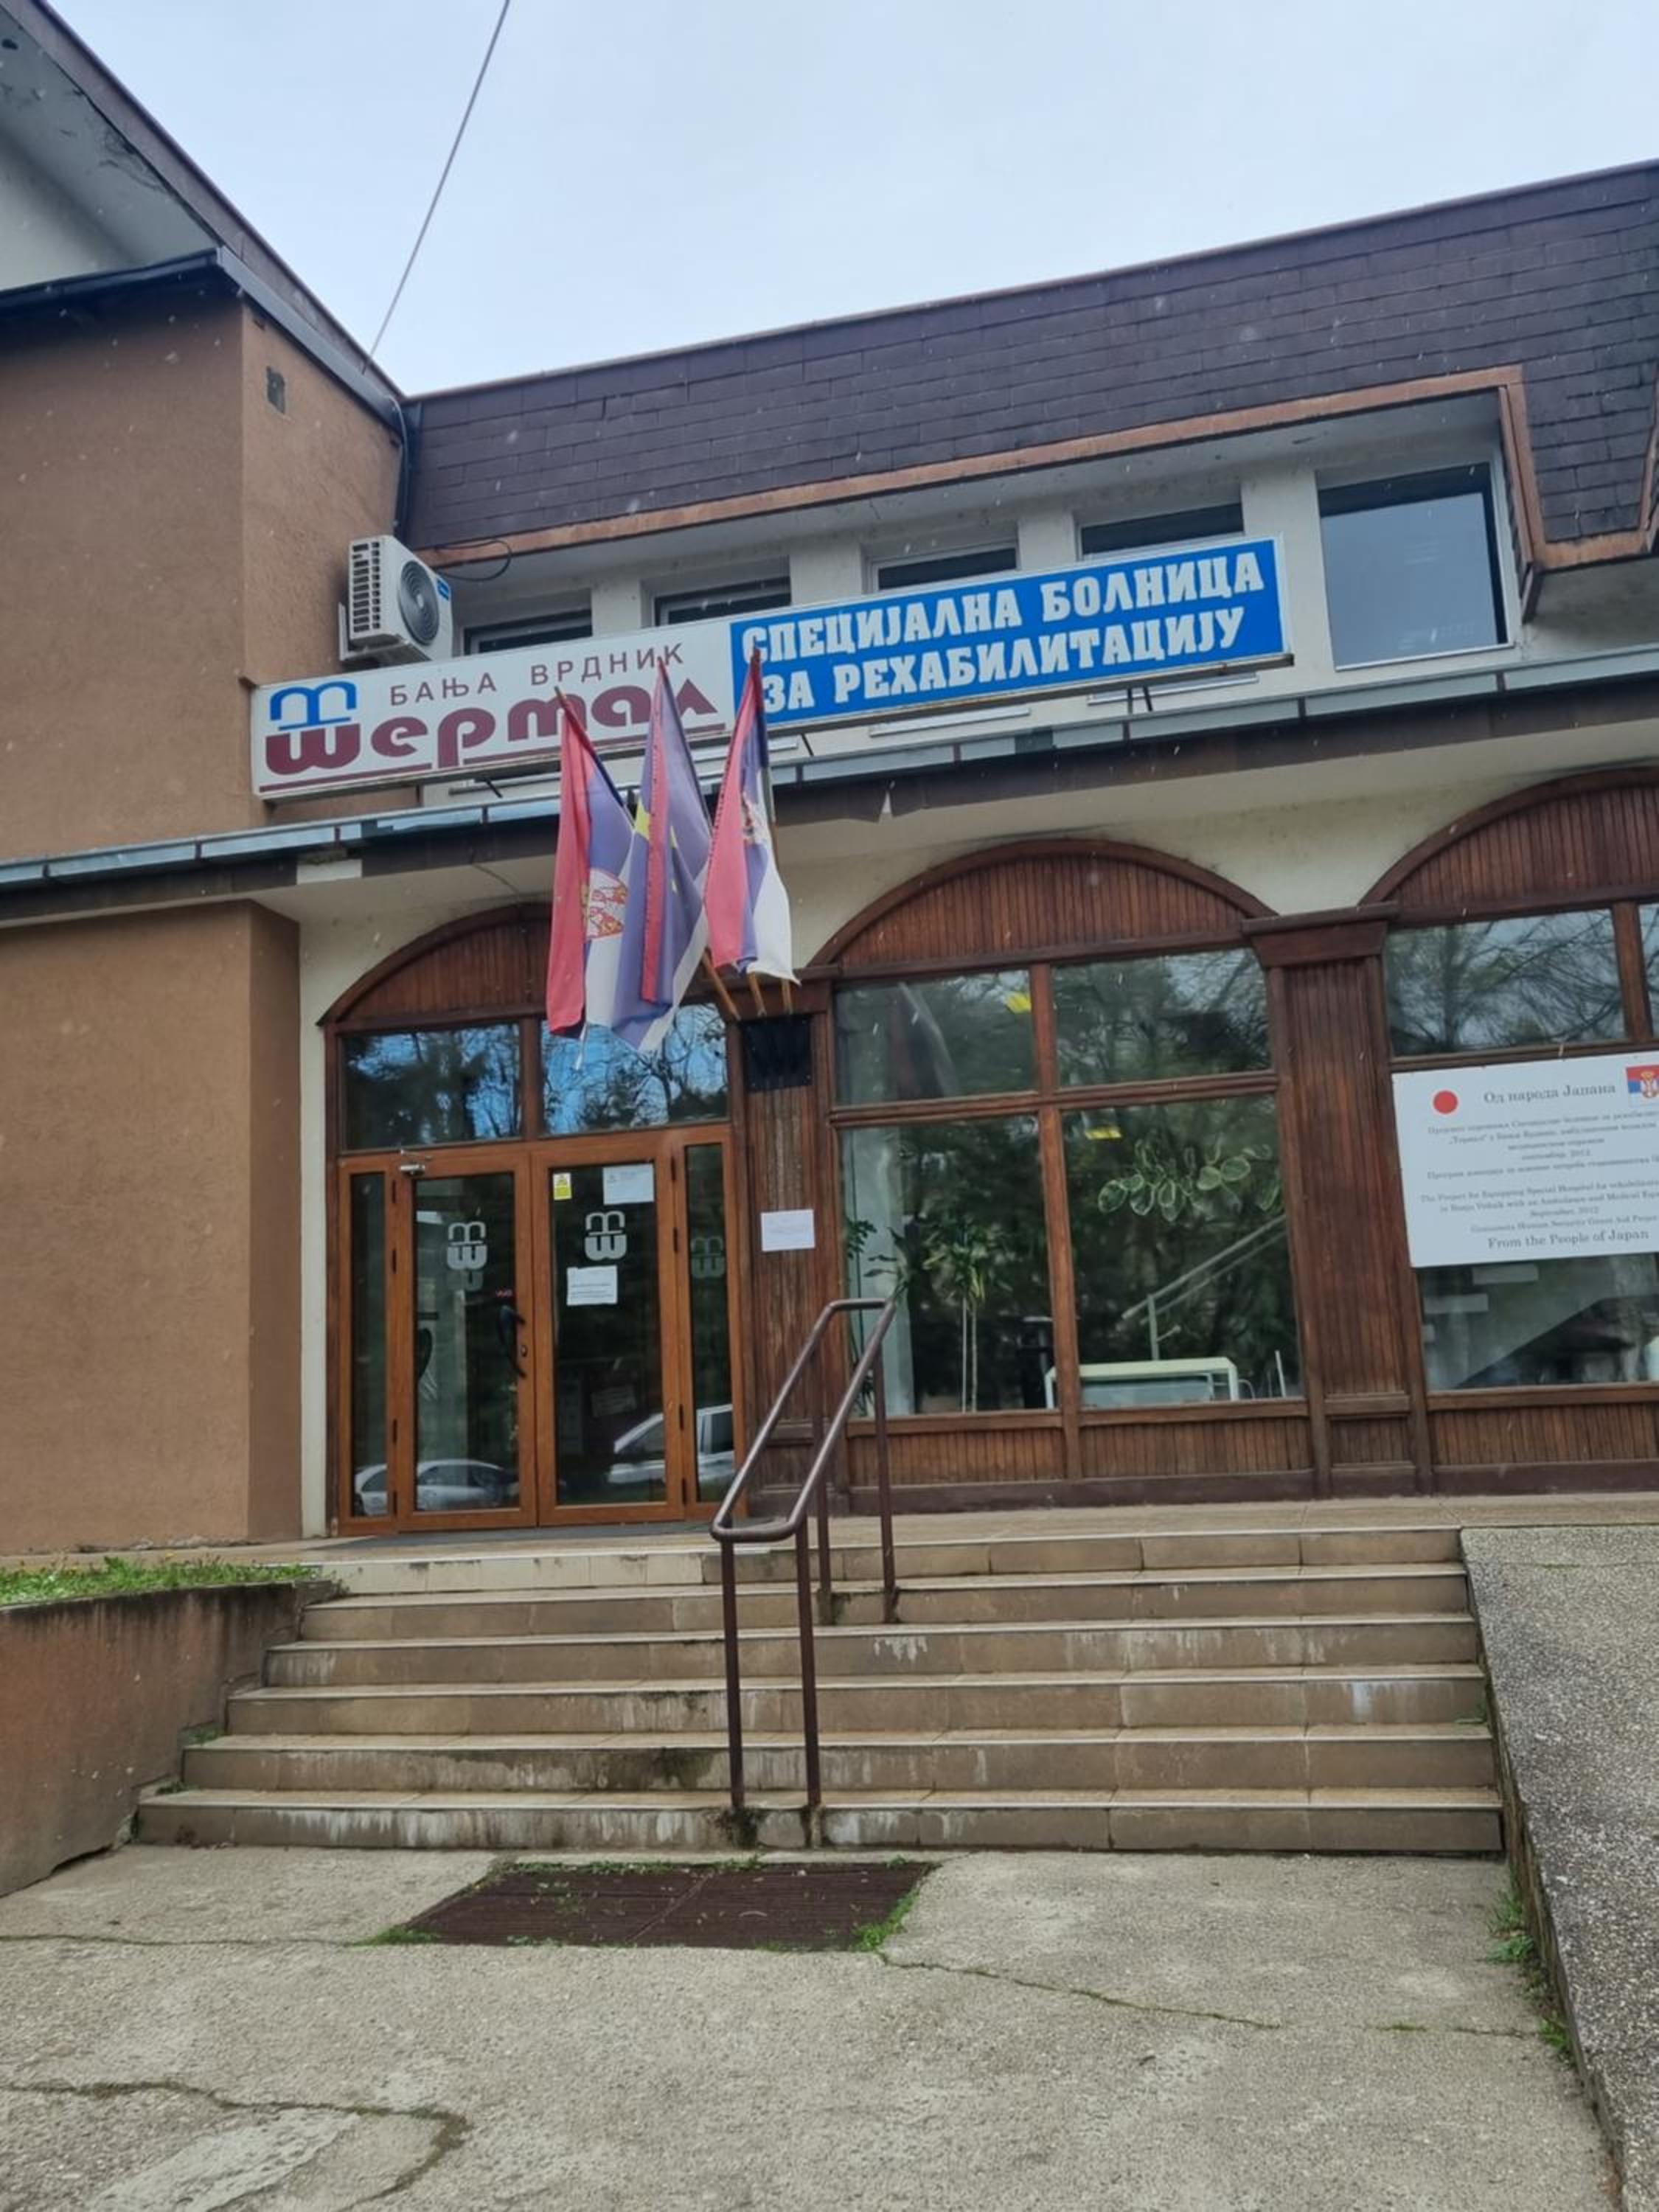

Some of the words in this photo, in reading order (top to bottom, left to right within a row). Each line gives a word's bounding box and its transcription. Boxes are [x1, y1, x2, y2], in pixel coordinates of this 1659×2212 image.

[742, 589, 1022, 663] СПЕЦИЈАЛНА
[1040, 552, 1264, 622] БОЛНИЦА
[390, 672, 496, 706] БАЊА
[531, 642, 684, 685] ВРДНИК
[762, 672, 814, 714] ЗА
[834, 607, 1245, 703] РЕХАБИЛИТАЦИЈУ
[1488, 1237, 1522, 1248] From
[1526, 1234, 1546, 1246] the
[1549, 1231, 1589, 1246] People
[1607, 1228, 1650, 1242] Japan
